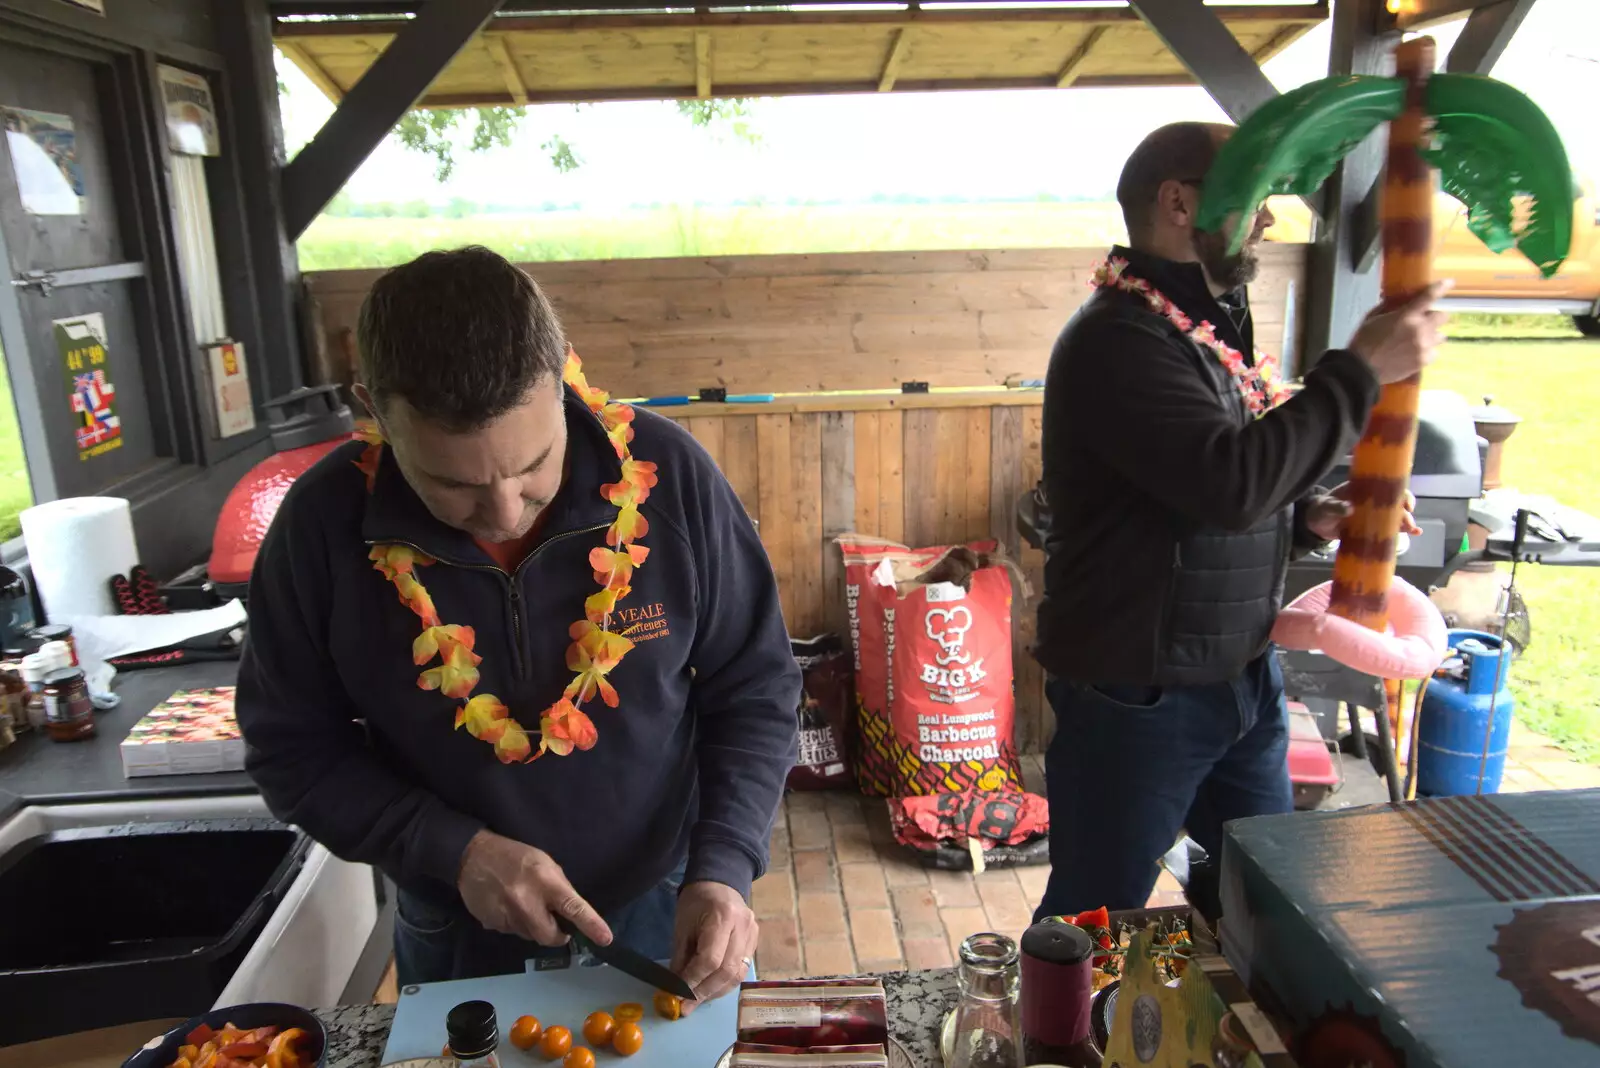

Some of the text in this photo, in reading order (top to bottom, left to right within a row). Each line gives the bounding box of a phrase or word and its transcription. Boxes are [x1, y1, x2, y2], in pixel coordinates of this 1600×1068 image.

[618, 603, 666, 623] VEALE
[920, 658, 987, 687] BIG K
[917, 708, 996, 725] Real Lumpwood
[918, 724, 997, 743] Barbecue
[919, 740, 1000, 763] Charcoal
